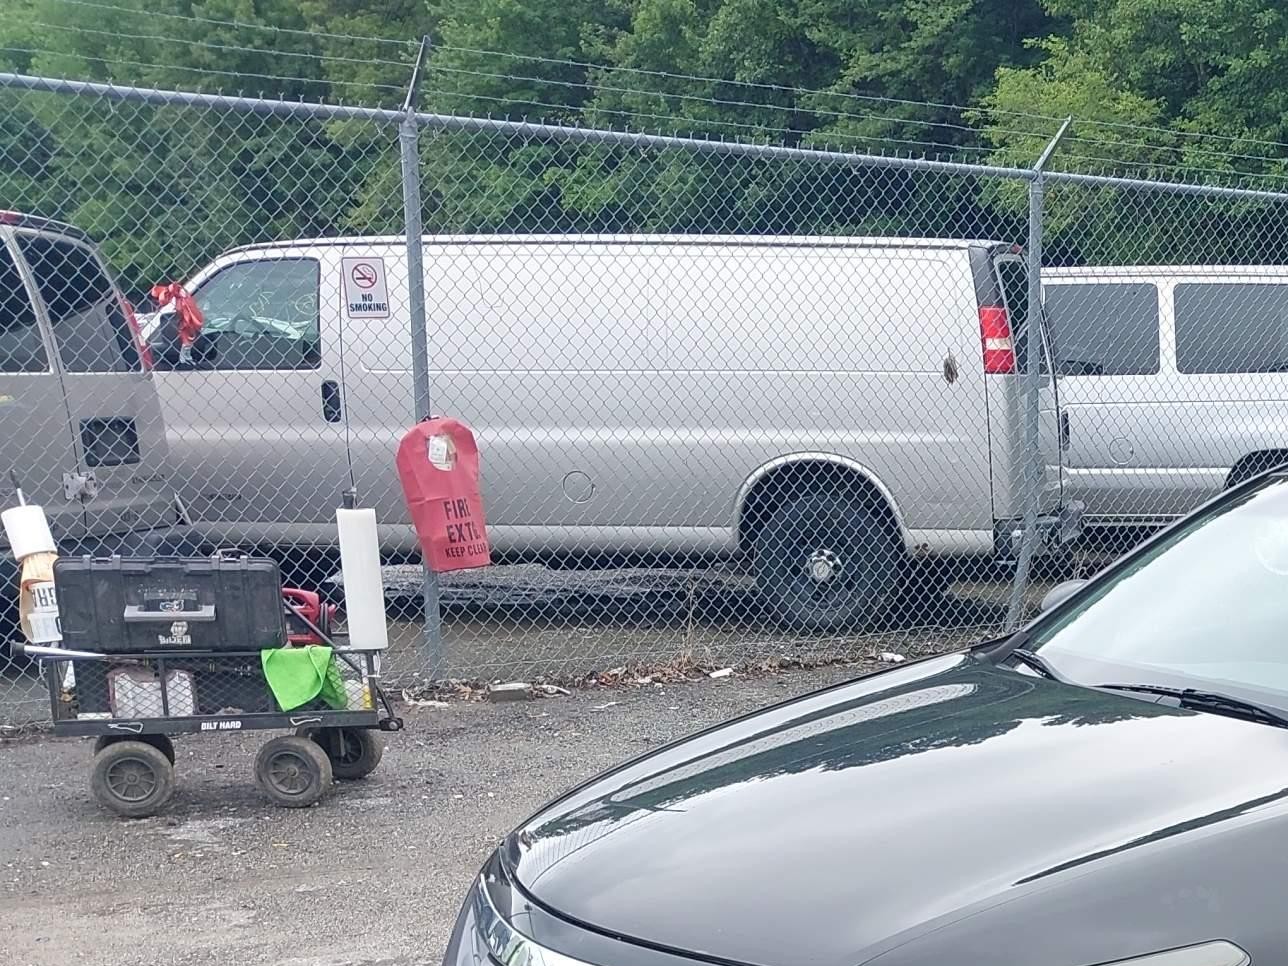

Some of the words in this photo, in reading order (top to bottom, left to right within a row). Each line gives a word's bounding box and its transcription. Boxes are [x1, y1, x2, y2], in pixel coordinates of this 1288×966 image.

[361, 293, 374, 302] NO
[350, 303, 388, 312] SMOKING
[445, 546, 466, 558] KEEP
[219, 721, 242, 730] HARD
